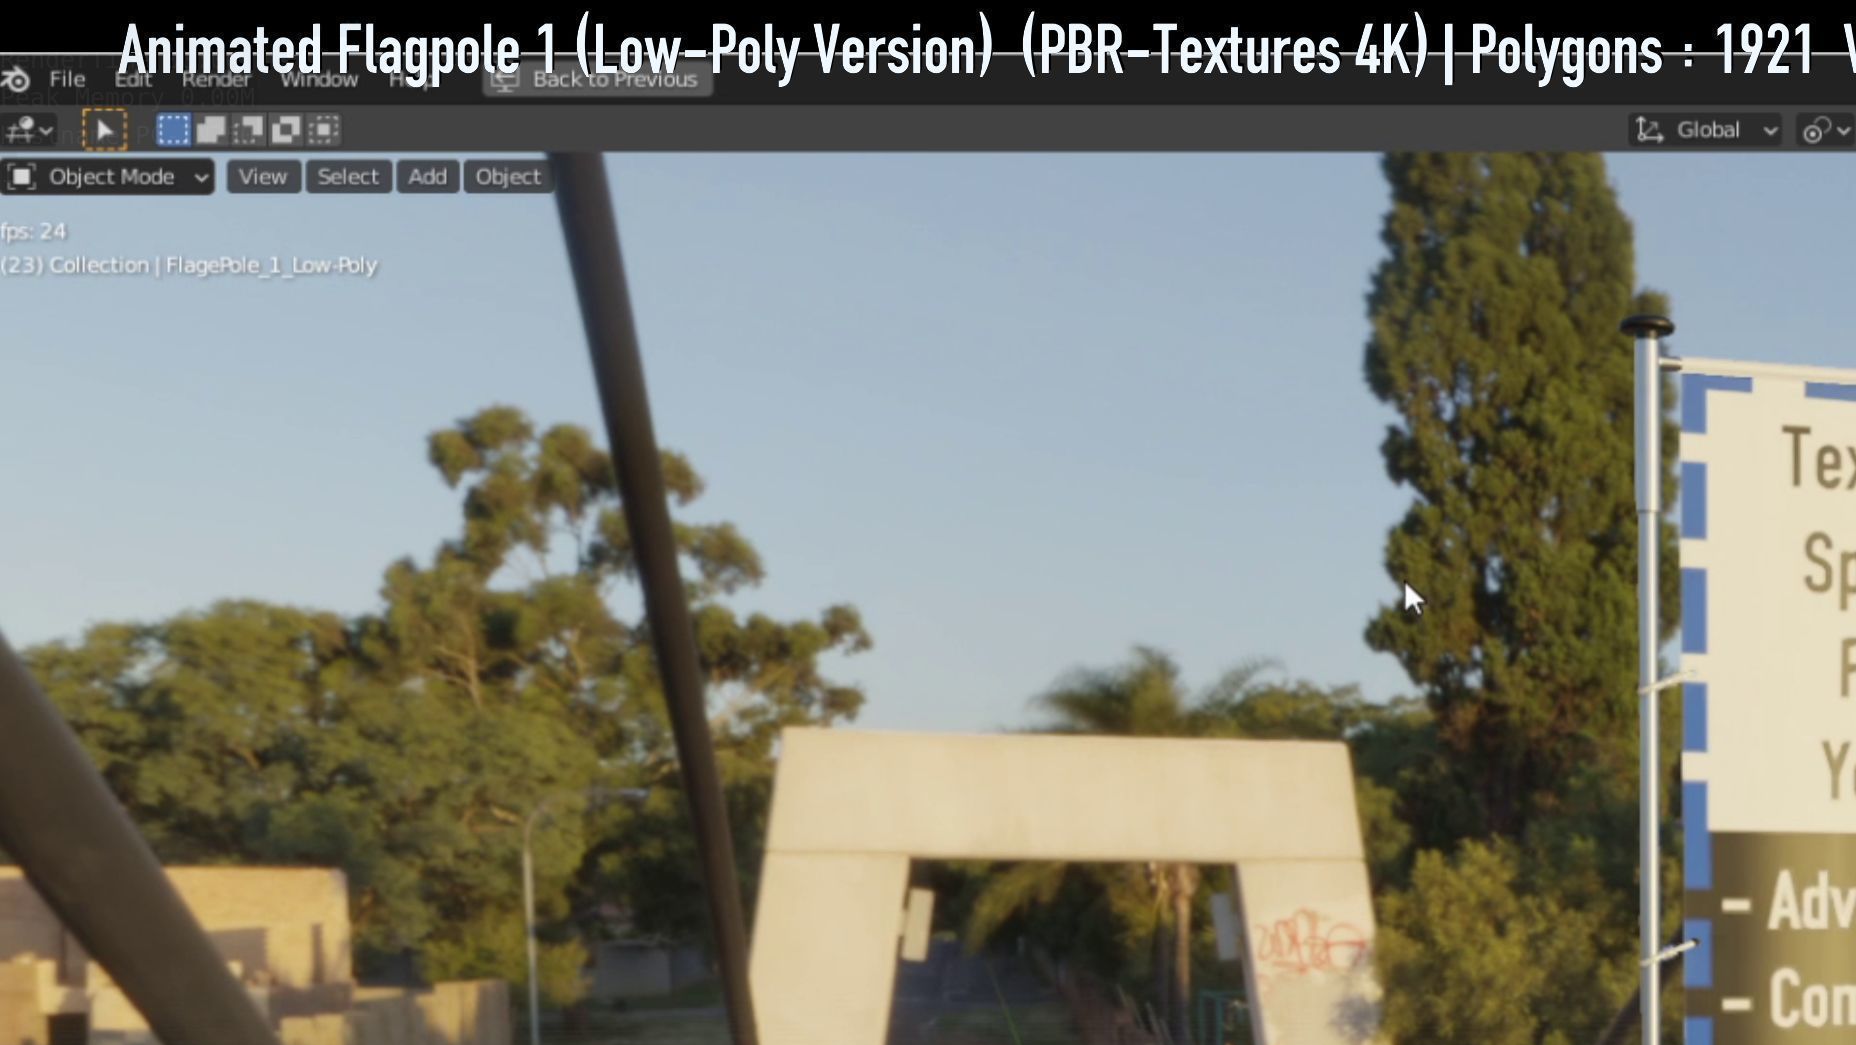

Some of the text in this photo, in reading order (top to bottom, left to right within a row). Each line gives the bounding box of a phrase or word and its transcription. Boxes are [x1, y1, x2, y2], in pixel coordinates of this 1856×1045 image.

[50, 70, 86, 88] File
[115, 70, 153, 88] Edit
[182, 70, 252, 88] Render
[281, 70, 358, 88] Window
[534, 70, 698, 88] Back to Previous
[1677, 120, 1740, 140] Global
[49, 167, 175, 190] Object Mode
[238, 168, 288, 186] View
[317, 167, 380, 186] Select
[408, 167, 448, 186] Add
[475, 167, 542, 190] Object
[0, 222, 67, 244] fps: 24
[0, 256, 44, 276] (23)
[49, 256, 149, 274] Collection
